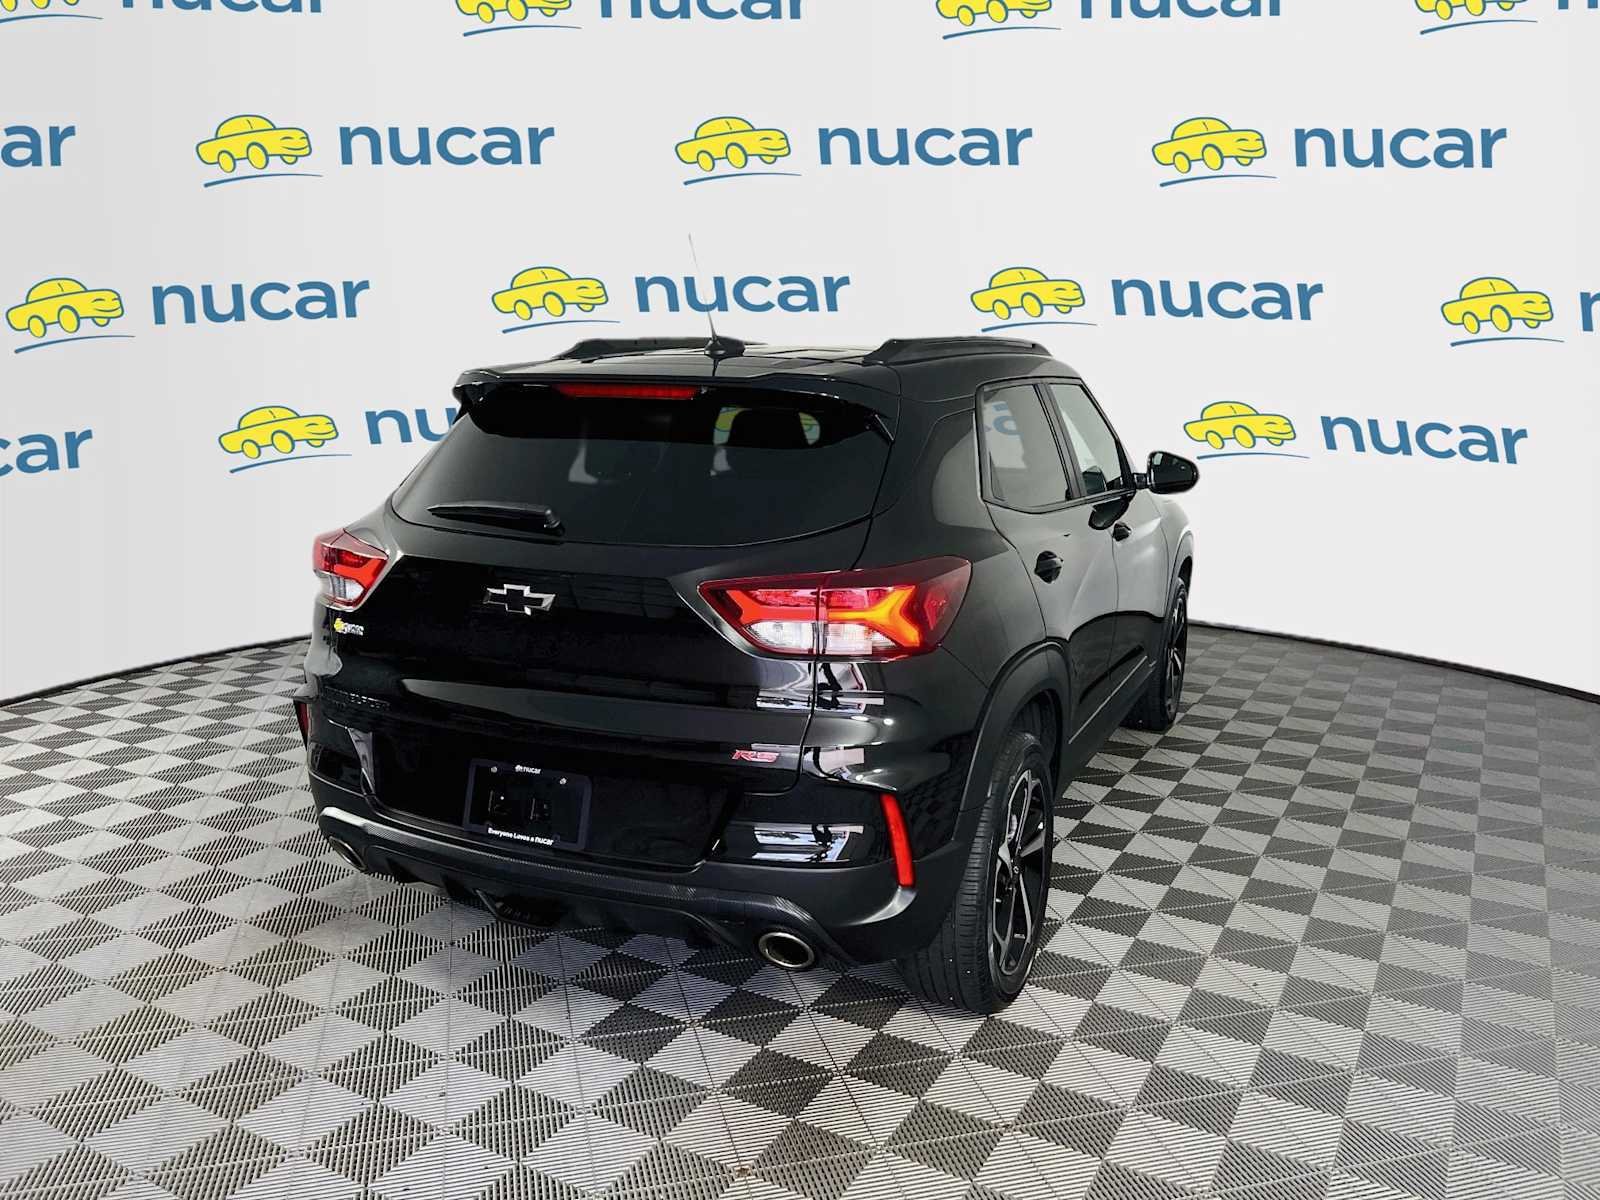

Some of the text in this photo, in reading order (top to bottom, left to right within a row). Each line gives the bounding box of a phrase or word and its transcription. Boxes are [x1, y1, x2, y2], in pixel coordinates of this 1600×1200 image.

[339, 126, 556, 166] nucar
[819, 127, 1033, 167] nucar
[1295, 127, 1508, 169] nucar
[152, 280, 370, 325] nucar
[634, 275, 850, 313] nucar
[1111, 279, 1323, 321] nucar
[1320, 415, 1529, 465] nucar
[731, 749, 780, 763] RS
[535, 836, 554, 846] nucar
